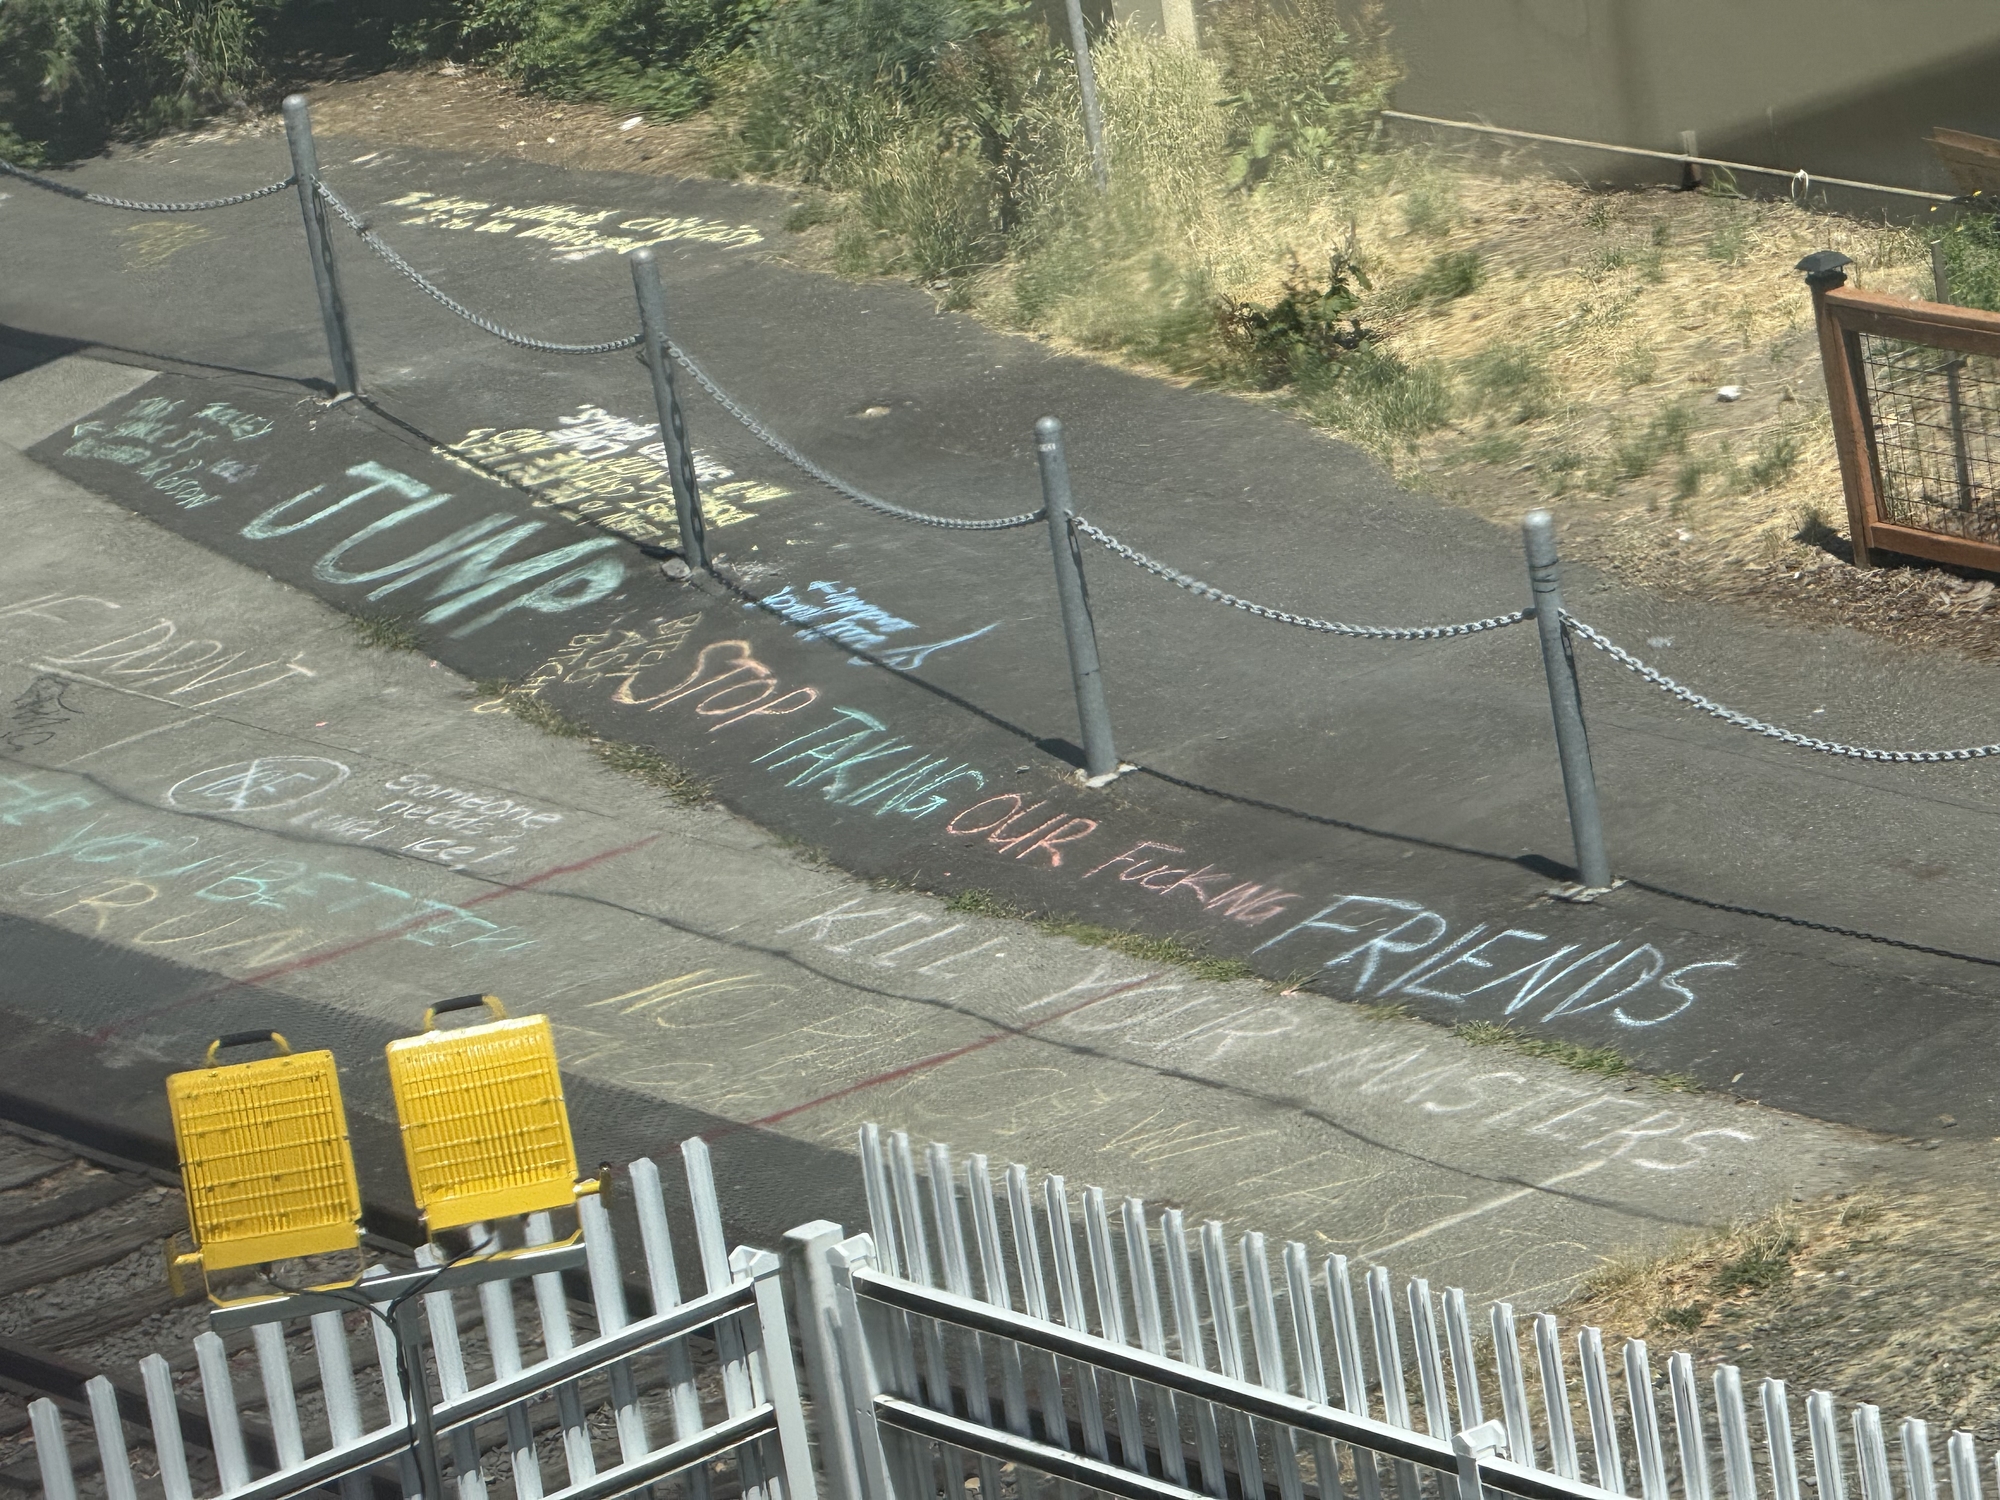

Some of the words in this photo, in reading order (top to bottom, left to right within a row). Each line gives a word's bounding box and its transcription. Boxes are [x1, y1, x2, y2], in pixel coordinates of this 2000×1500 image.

[240, 460, 625, 640] JUMP
[612, 640, 822, 733] STOP
[750, 707, 985, 820] TAKING
[946, 791, 1098, 867] OUR
[1253, 895, 1740, 1028] FRIENDS
